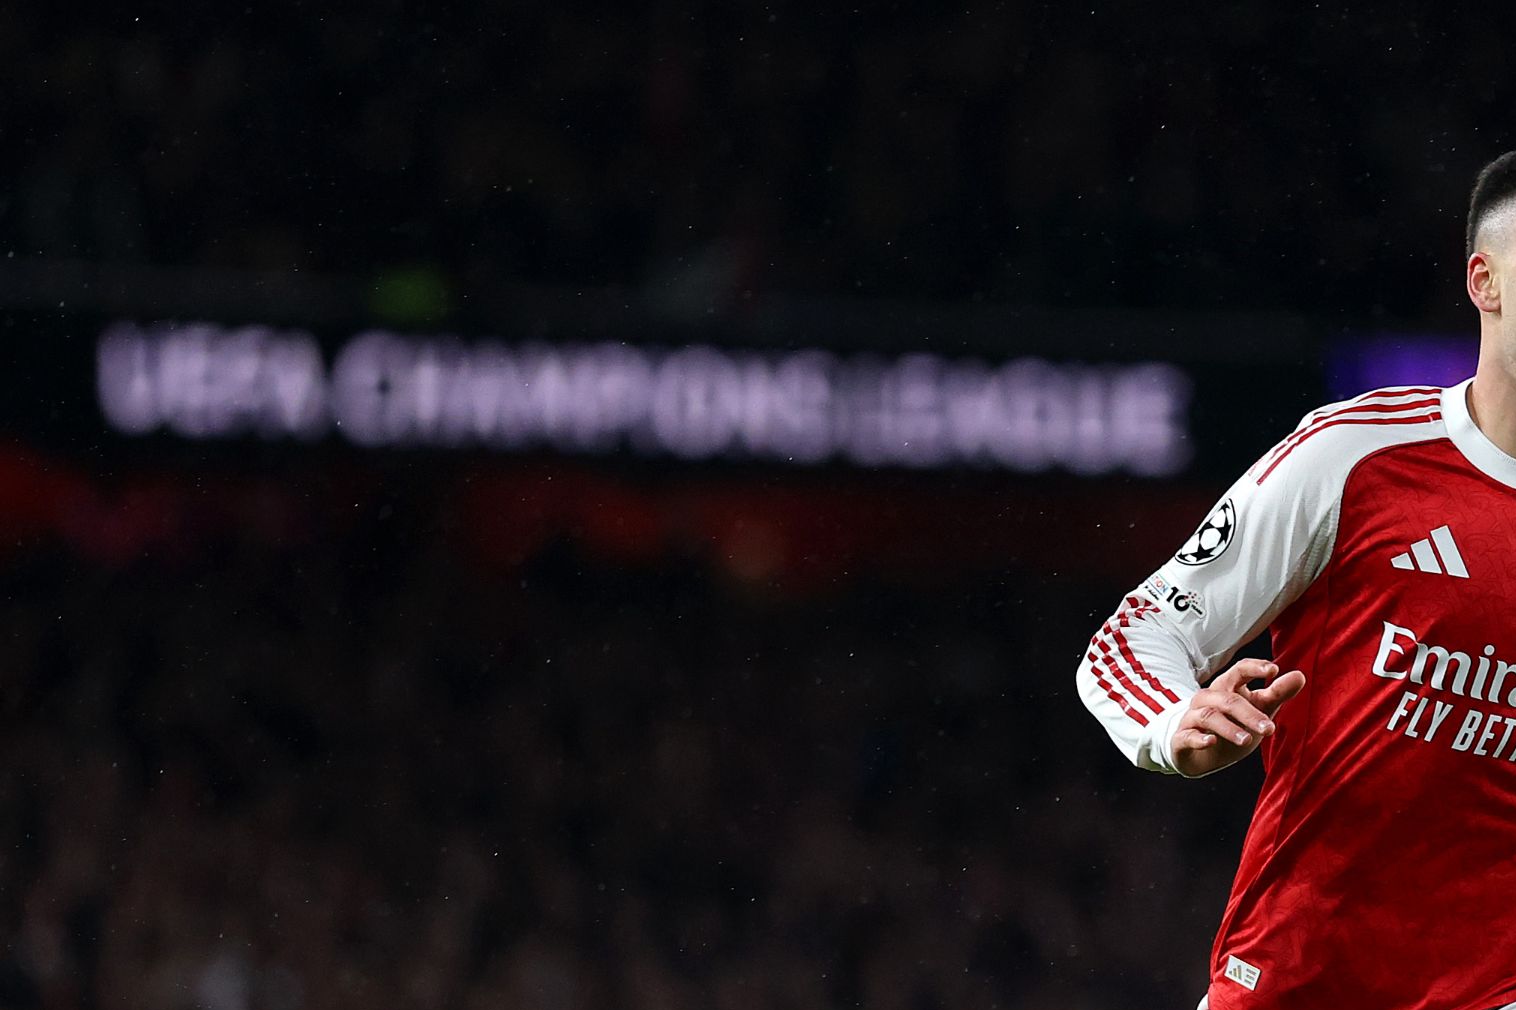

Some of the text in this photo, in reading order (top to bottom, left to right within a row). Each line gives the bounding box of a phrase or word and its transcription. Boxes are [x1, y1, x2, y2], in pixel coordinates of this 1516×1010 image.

[332, 330, 833, 462] CHAMPIONS
[836, 352, 1188, 478] LEAGUE
[1166, 586, 1190, 612] 10
[1386, 691, 1454, 742] FLY
